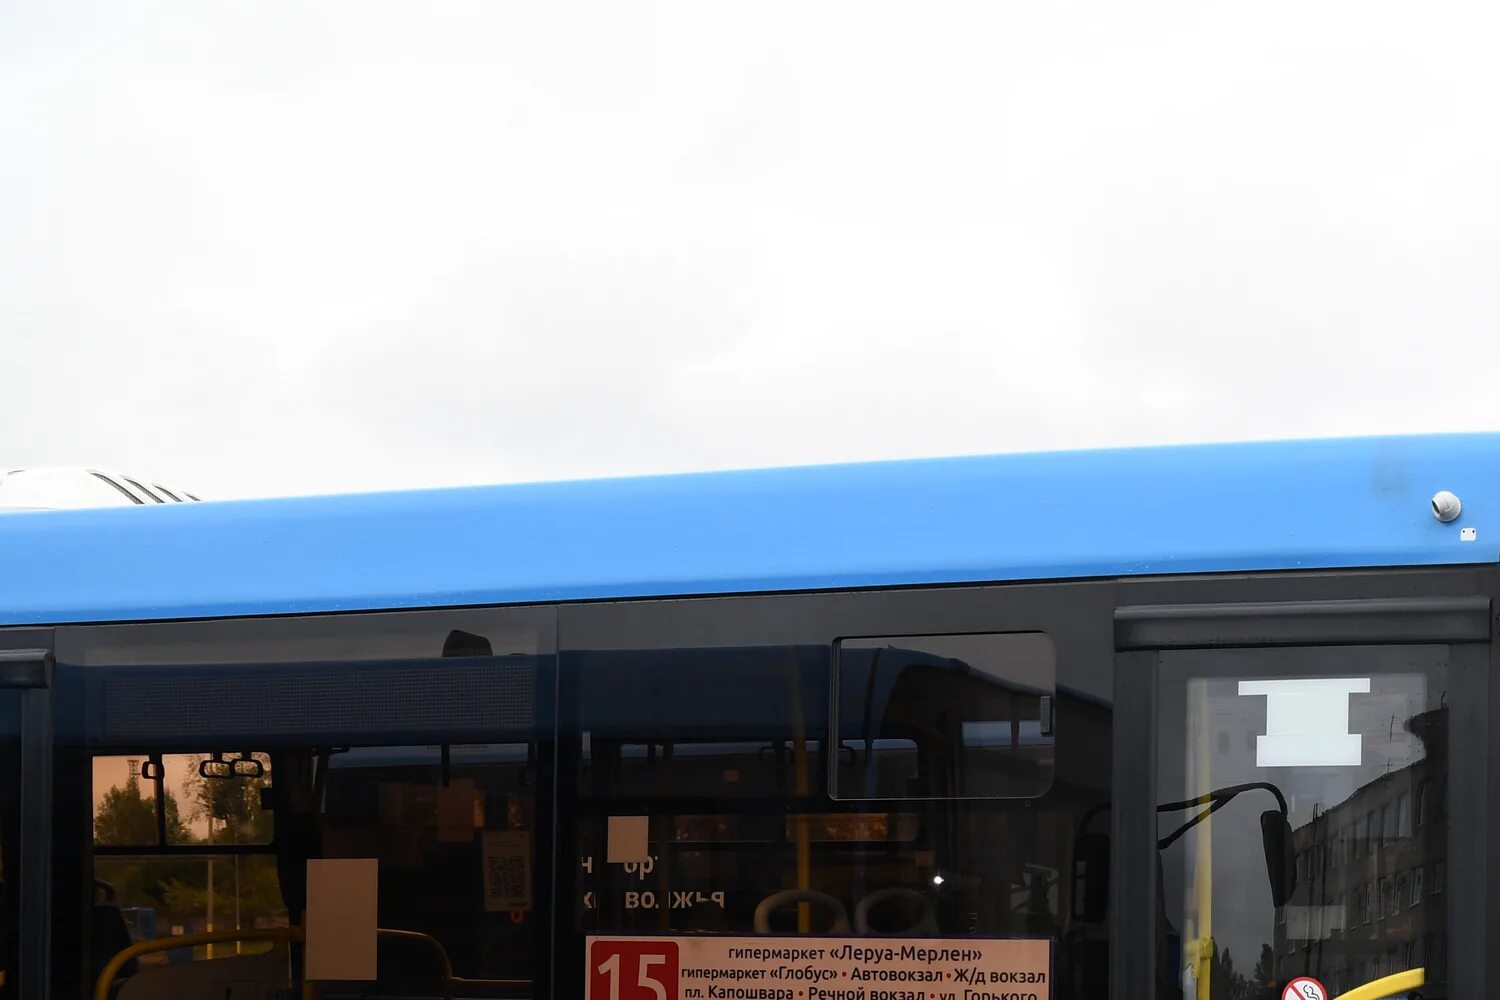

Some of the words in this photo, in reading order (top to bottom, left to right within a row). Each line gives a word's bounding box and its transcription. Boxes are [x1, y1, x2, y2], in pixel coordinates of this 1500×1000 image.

[728, 948, 826, 963] гипермаркет
[829, 944, 982, 965] «Леруа-Мерлен»
[681, 968, 767, 982] гипермаркет
[769, 964, 838, 984] «Глобус»
[850, 966, 943, 982] Автовокзал
[953, 966, 986, 986] Ж/д
[990, 972, 1046, 984] вокзал
[684, 988, 705, 999] пл.
